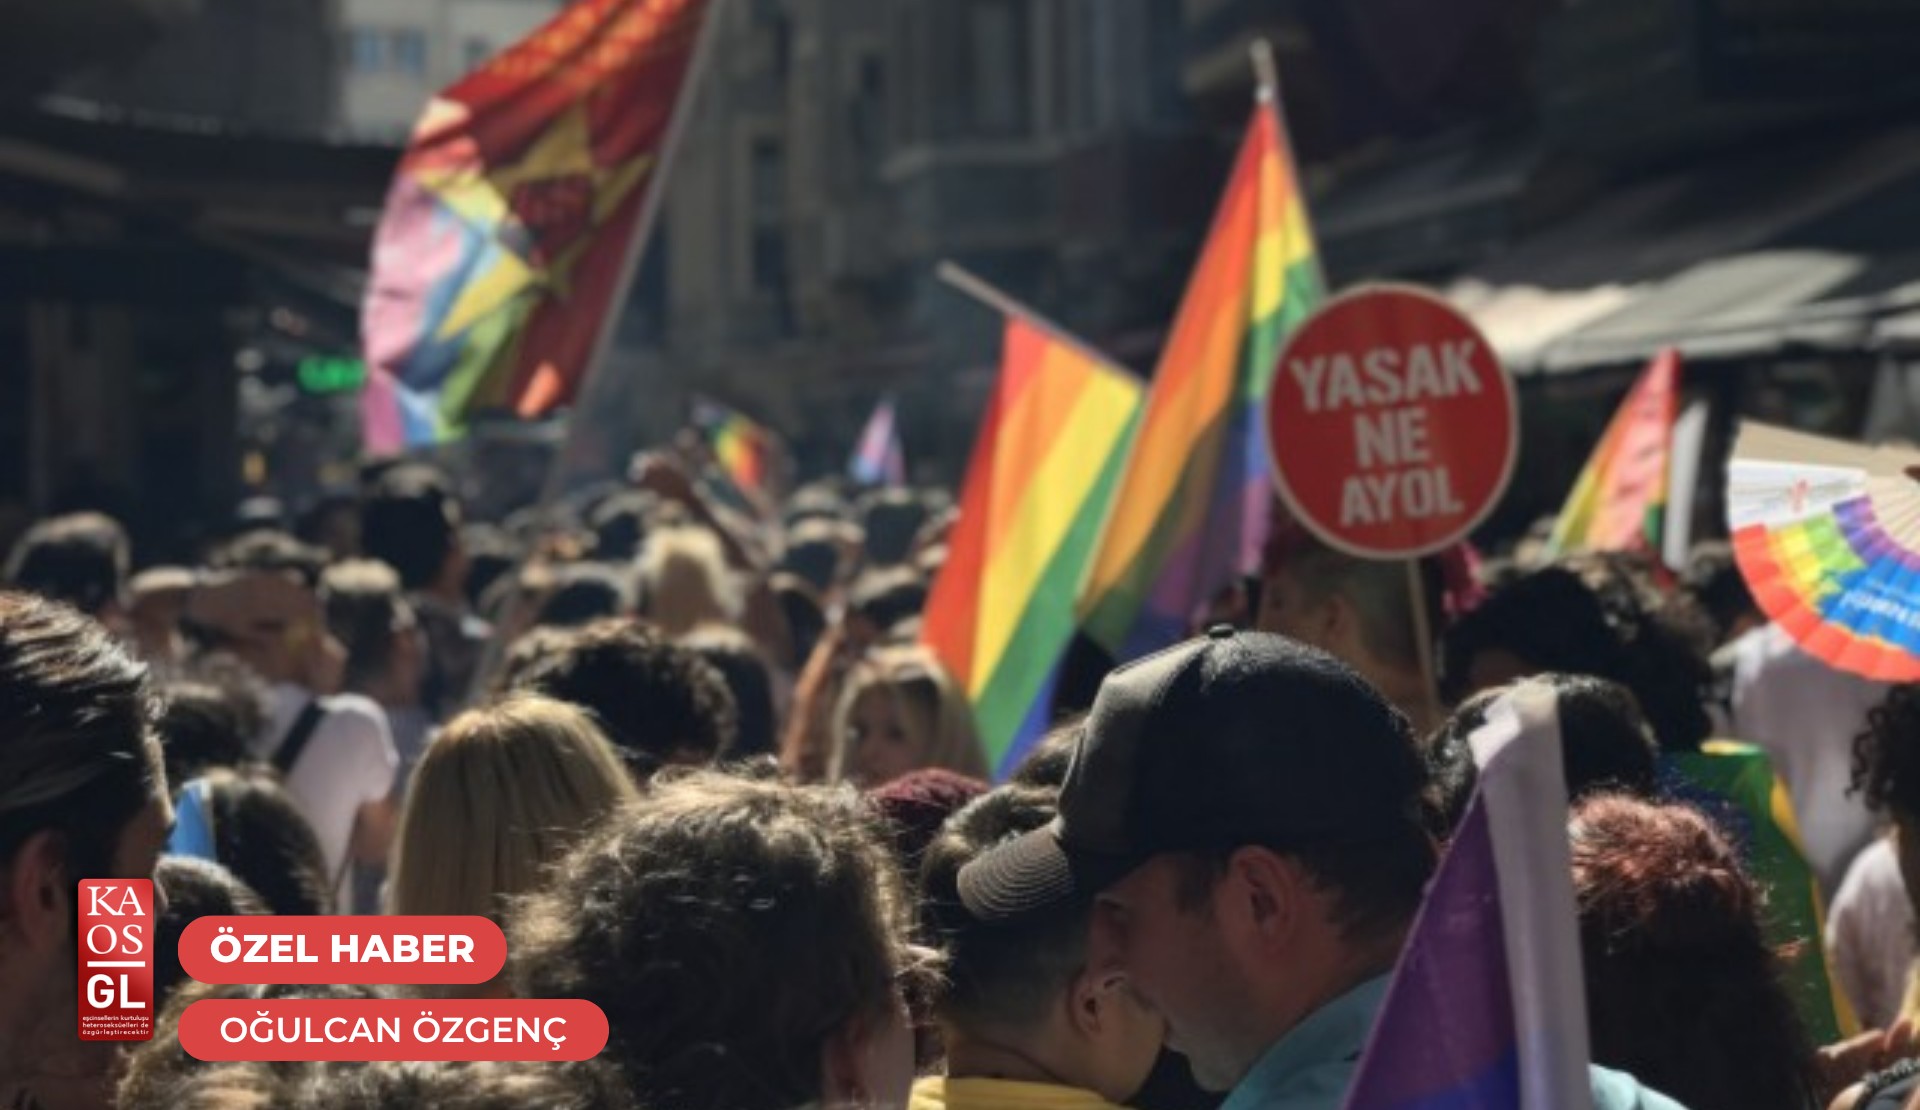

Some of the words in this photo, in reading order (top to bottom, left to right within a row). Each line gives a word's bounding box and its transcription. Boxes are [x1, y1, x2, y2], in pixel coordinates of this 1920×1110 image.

[1290, 339, 1481, 413] YASAK
[1354, 406, 1430, 468] NE
[1339, 467, 1465, 527] AYOL
